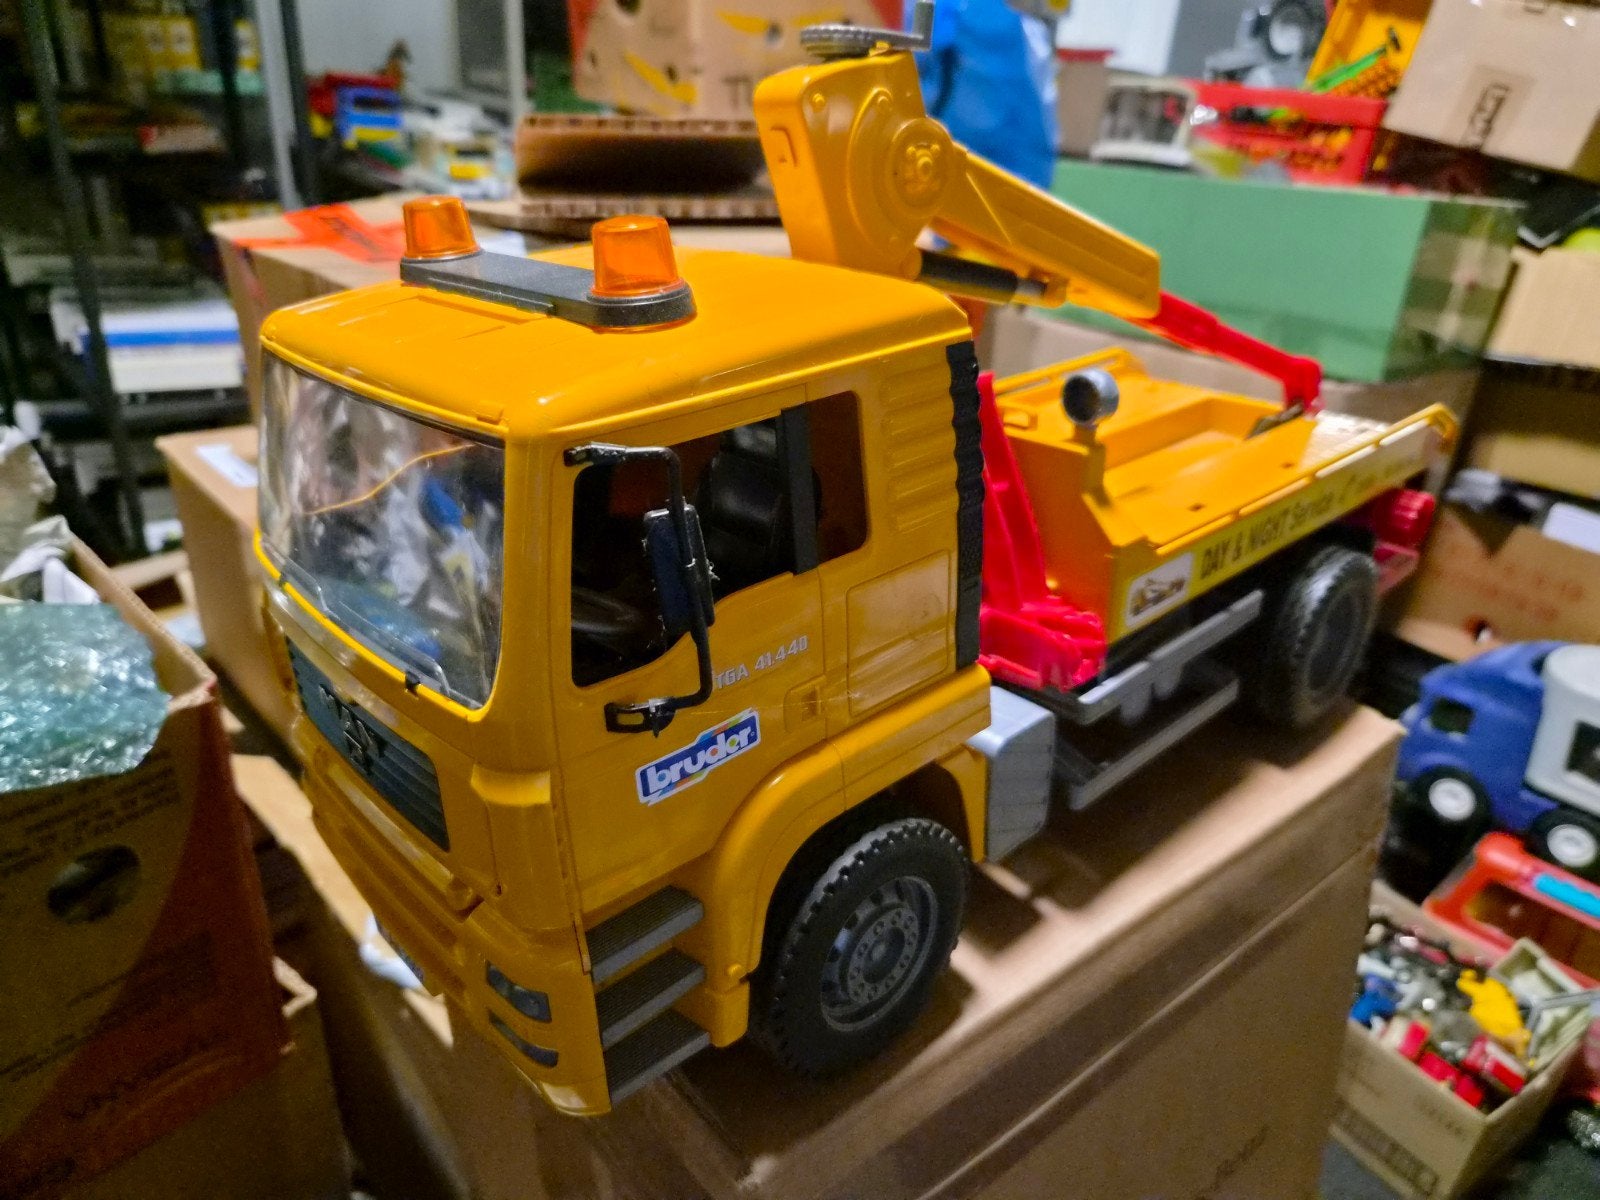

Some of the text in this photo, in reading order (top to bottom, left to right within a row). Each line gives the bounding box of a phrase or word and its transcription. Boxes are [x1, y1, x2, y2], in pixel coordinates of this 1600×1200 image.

[1201, 538, 1231, 580] DAY
[715, 634, 808, 689] TGA 41.440
[646, 726, 752, 794] bruder
